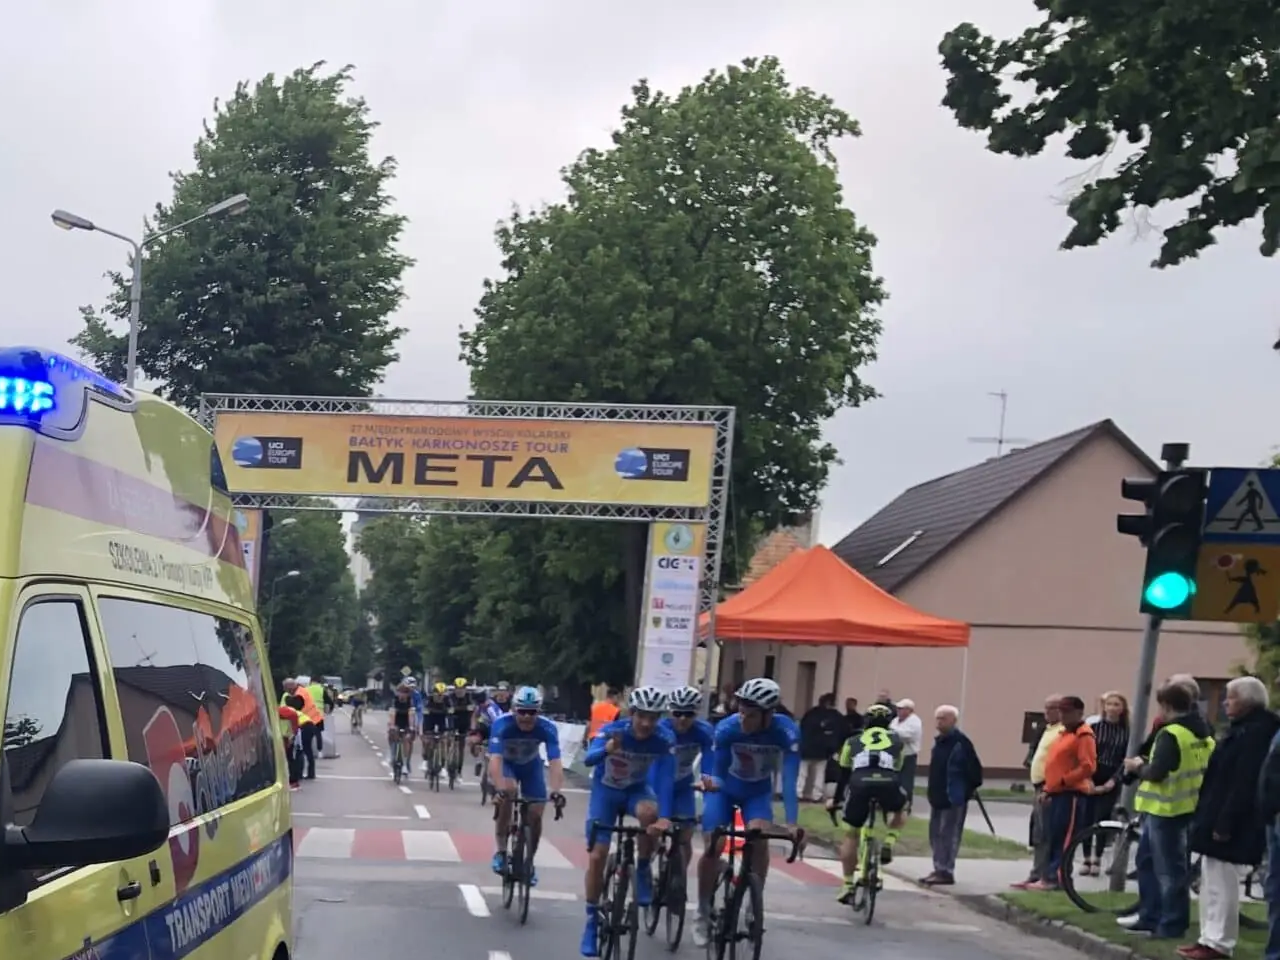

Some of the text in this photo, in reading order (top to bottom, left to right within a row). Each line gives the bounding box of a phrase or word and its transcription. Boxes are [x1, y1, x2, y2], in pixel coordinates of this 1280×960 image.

[526, 441, 569, 453] TOUR
[268, 456, 287, 464] TOUR
[653, 453, 670, 461] UCI
[347, 450, 565, 490] META
[165, 886, 231, 951] TRANSPORT
